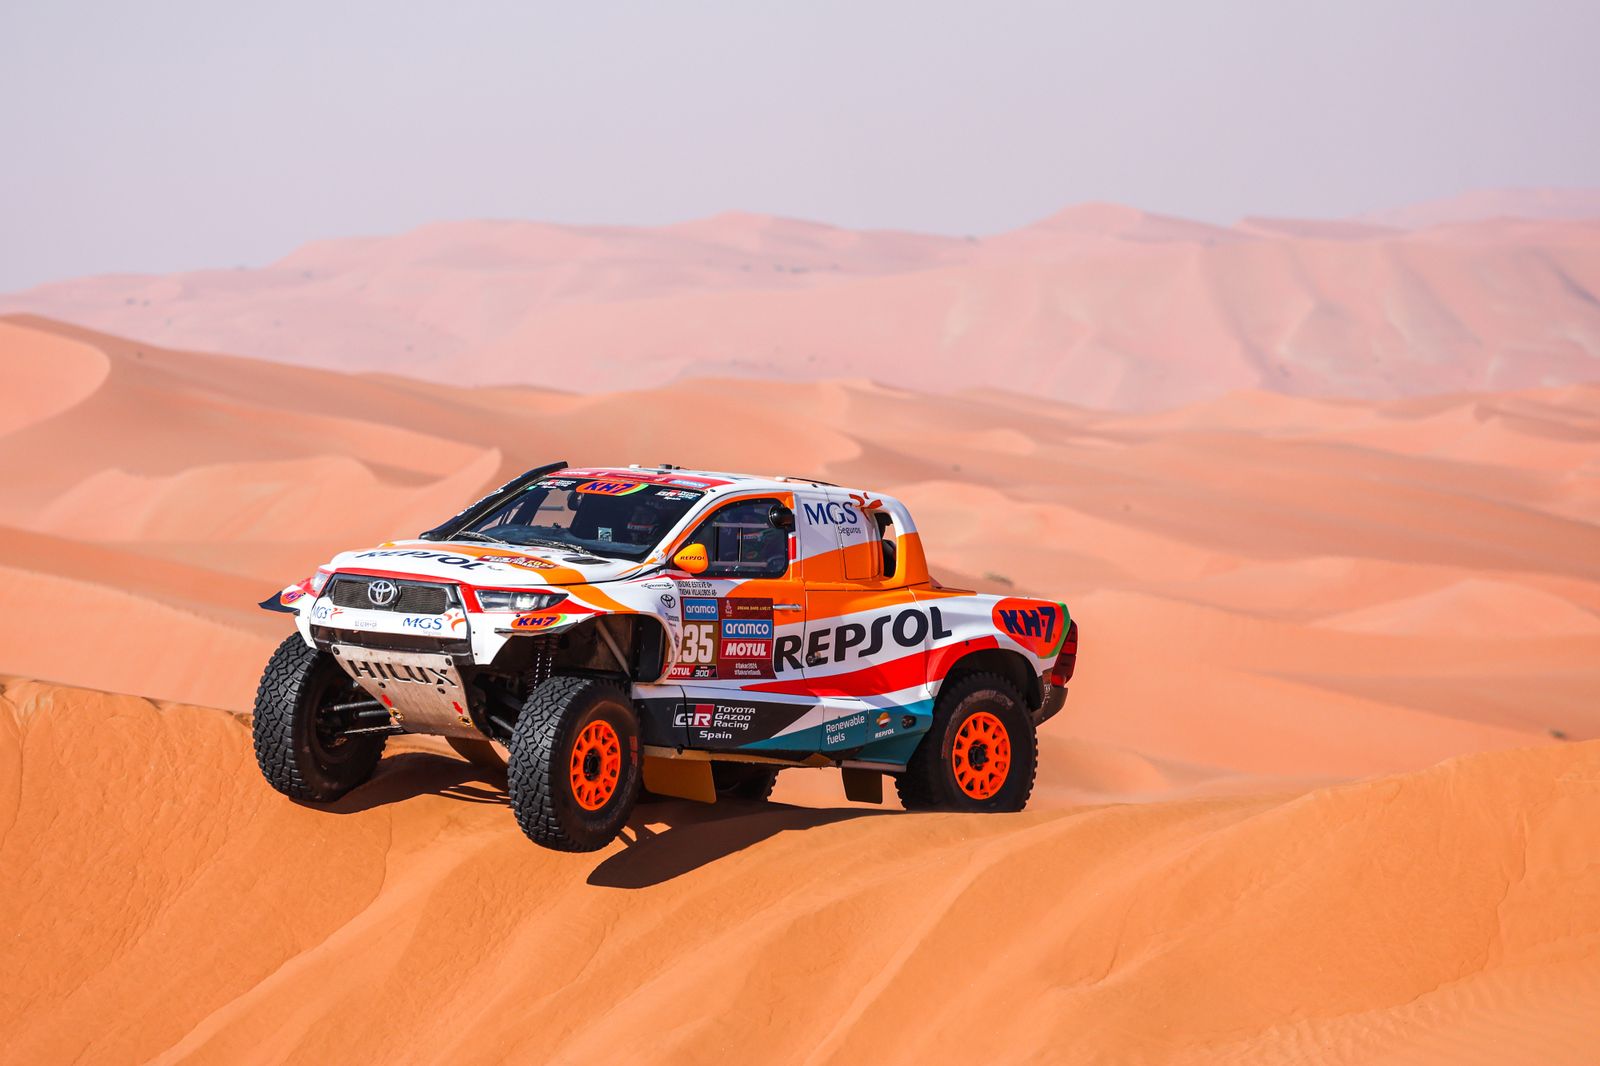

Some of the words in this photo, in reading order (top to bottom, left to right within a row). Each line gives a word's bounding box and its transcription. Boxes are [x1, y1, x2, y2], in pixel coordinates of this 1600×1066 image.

[803, 502, 858, 525] MGS
[837, 525, 861, 536] Seguros
[355, 550, 484, 570] REPSOL
[686, 605, 716, 614] aramco
[403, 617, 443, 630] MGS
[725, 623, 769, 634] aramco
[774, 606, 952, 673] REPSOL
[725, 643, 767, 656] MOTUL
[347, 660, 458, 688] HILUX
[716, 705, 756, 714] TOYOTA
[675, 713, 711, 726] GR
[714, 713, 751, 721] GAZOO
[713, 721, 749, 730] Racing
[826, 715, 865, 733] Renewable
[699, 730, 732, 740] Spain
[827, 733, 846, 745] fuels
[875, 728, 894, 738] REPSOL
